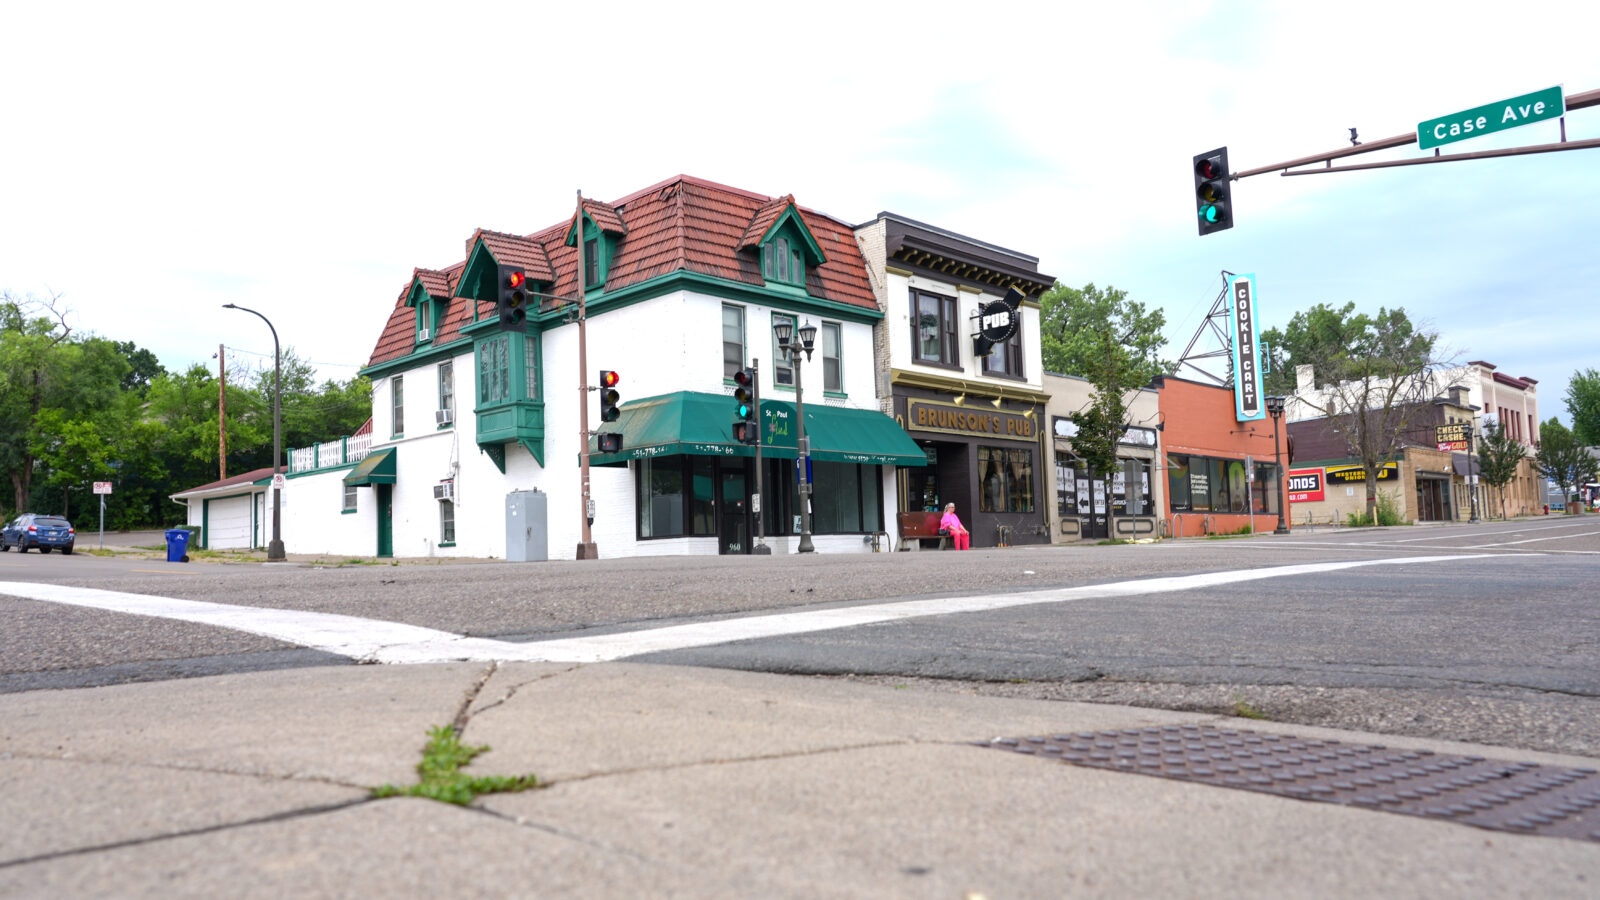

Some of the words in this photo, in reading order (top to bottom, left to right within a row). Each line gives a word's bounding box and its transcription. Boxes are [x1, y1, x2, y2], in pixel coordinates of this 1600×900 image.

[1434, 116, 1486, 140] Case
[1501, 101, 1545, 123] Ave
[983, 311, 1010, 330] PUB
[1238, 289, 1250, 354] COOKIE
[1243, 360, 1253, 404] CART
[776, 410, 788, 418] Paul
[918, 407, 1000, 433] BRUNSON'S
[1007, 418, 1031, 436] PUB
